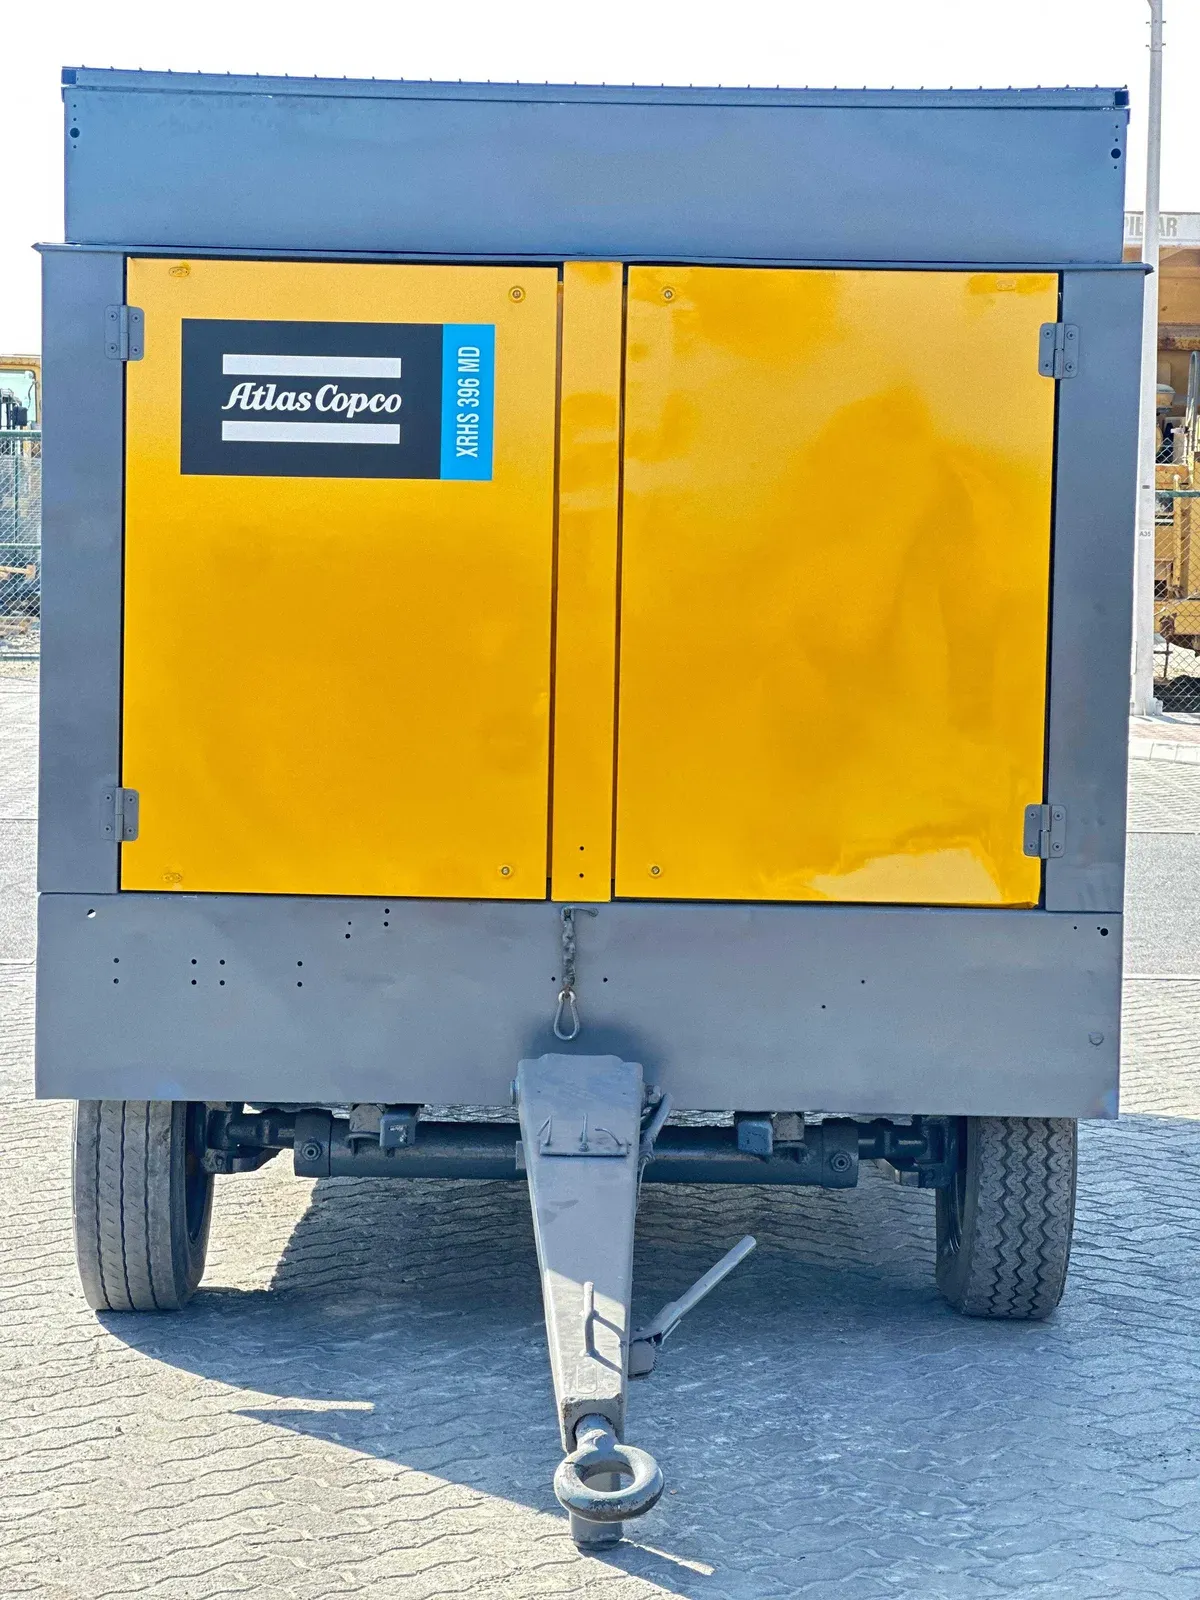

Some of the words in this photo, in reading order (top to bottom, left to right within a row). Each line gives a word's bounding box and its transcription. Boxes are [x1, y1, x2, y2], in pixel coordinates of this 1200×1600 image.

[457, 346, 480, 372] MD
[221, 382, 313, 412] Atlas
[315, 384, 402, 418] Copco
[457, 378, 480, 408] 396
[456, 413, 480, 458] XRHS
